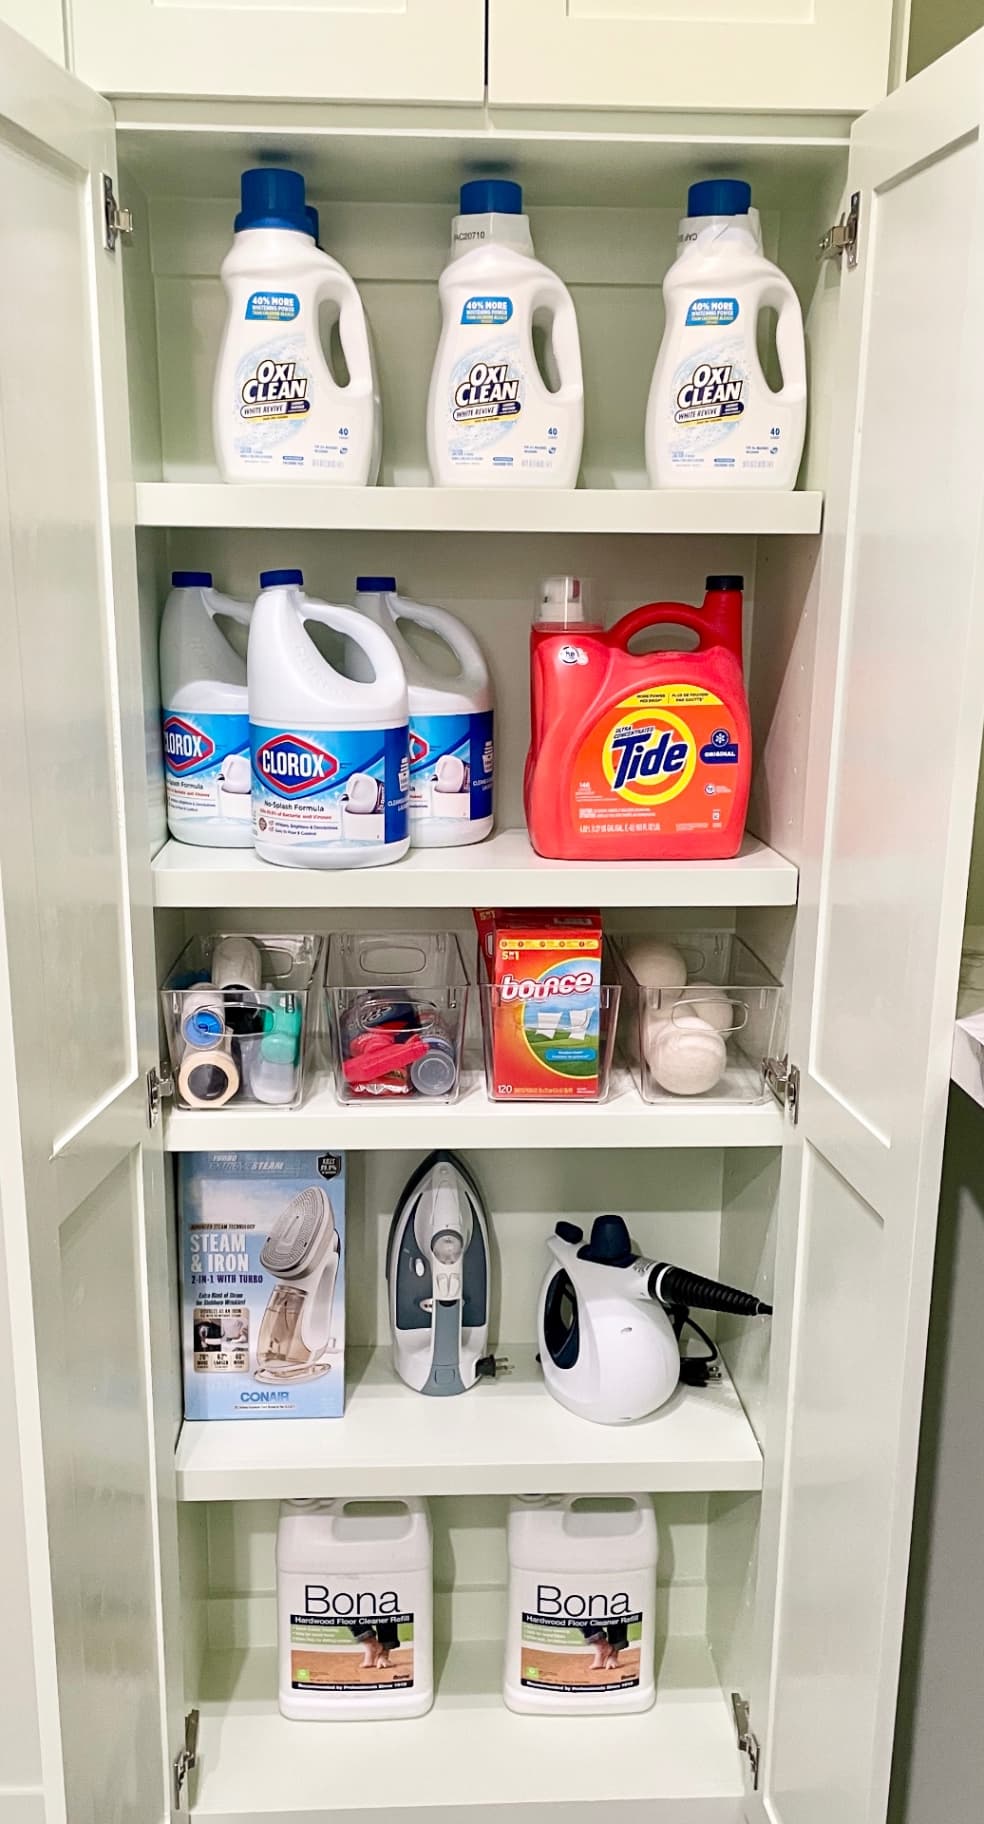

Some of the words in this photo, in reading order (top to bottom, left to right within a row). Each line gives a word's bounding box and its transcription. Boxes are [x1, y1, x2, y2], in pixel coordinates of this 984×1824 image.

[253, 296, 270, 305] 40%
[271, 297, 295, 307] MORE
[466, 301, 484, 310] 40%
[485, 301, 508, 310] MORE
[691, 302, 710, 311] 40%
[711, 302, 734, 311] MORE
[256, 360, 296, 384] OXI
[469, 363, 508, 387] OXI
[692, 364, 732, 388] OXI
[242, 379, 307, 404] CLEAN
[455, 380, 519, 407] CLEAN
[677, 380, 743, 409] CLEAN
[244, 407, 261, 416] WHITE
[263, 405, 283, 414] REVIVE
[456, 409, 473, 419] WHITE
[475, 406, 495, 416] REVIVE
[678, 410, 696, 421] WHITE
[697, 407, 717, 417] REVIVE
[338, 428, 349, 436] 40
[548, 427, 558, 436] 40
[770, 427, 780, 436] 40
[615, 726, 631, 734] ULTRA
[262, 750, 325, 778] CLOROX
[611, 732, 688, 790] Tide
[294, 803, 325, 813] Formula
[501, 972, 594, 1003] bounce
[498, 1084, 513, 1094] 120
[252, 1161, 284, 1170] STEAM
[191, 1233, 246, 1252] STEAM
[191, 1254, 203, 1273] &
[207, 1253, 249, 1273] IRON
[191, 1274, 214, 1284] 2-IN-1
[216, 1274, 236, 1284] WITH
[239, 1274, 264, 1284] TURBO
[240, 1391, 290, 1402] CONAIR
[305, 1585, 401, 1616] Bona
[537, 1585, 632, 1618] Bona
[295, 1616, 335, 1625] Hardwood
[336, 1617, 357, 1626] Floor
[358, 1616, 389, 1625] Cleaner
[390, 1615, 410, 1623] Refill
[526, 1615, 566, 1626] Hardwood
[567, 1619, 588, 1627] Floor
[589, 1616, 620, 1627] Cleaner
[620, 1614, 640, 1624] Refill
